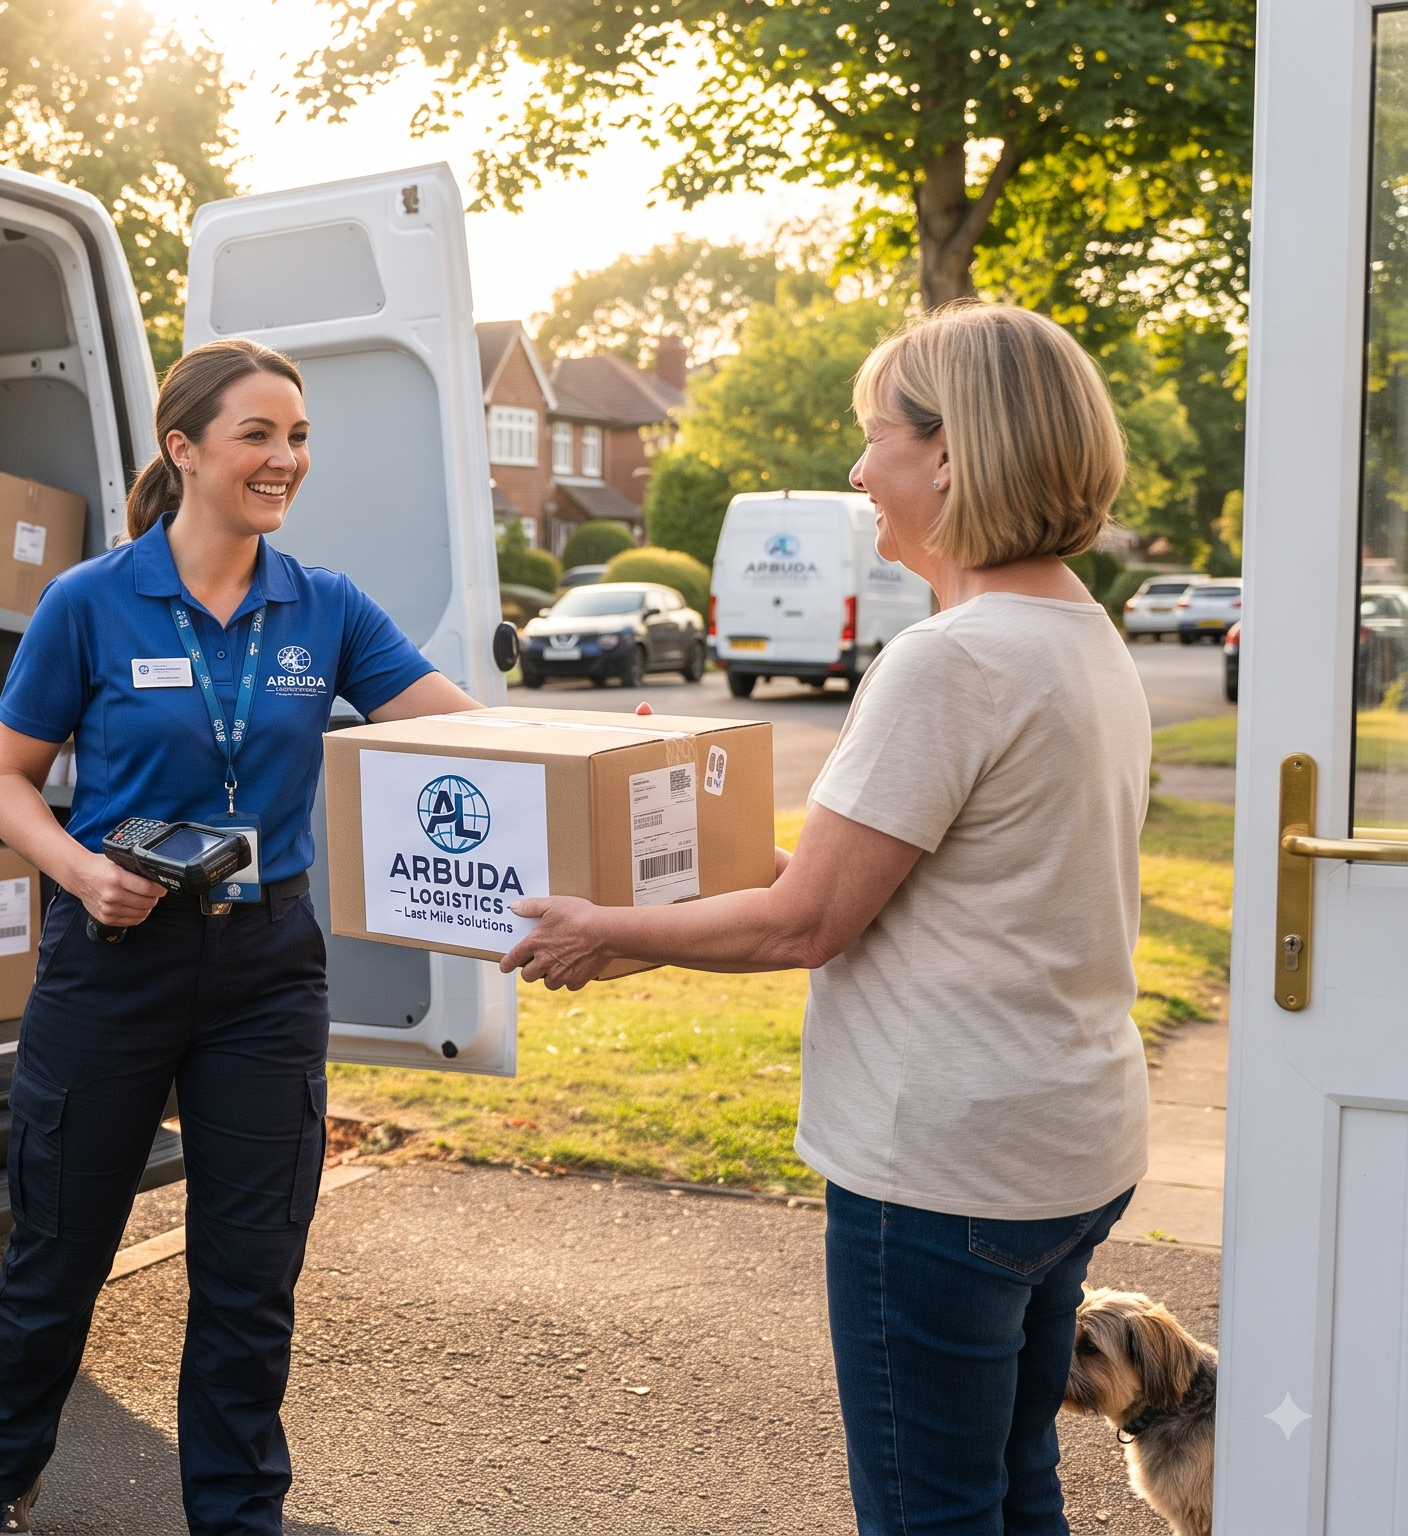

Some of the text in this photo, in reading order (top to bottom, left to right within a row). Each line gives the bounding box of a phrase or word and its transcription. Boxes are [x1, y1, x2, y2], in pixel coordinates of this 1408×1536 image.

[266, 675, 326, 688] ARBUDA
[389, 852, 524, 896] ARBUDA
[410, 886, 504, 915] LOGISTICS
[404, 906, 514, 933] Last Mile Solutions
